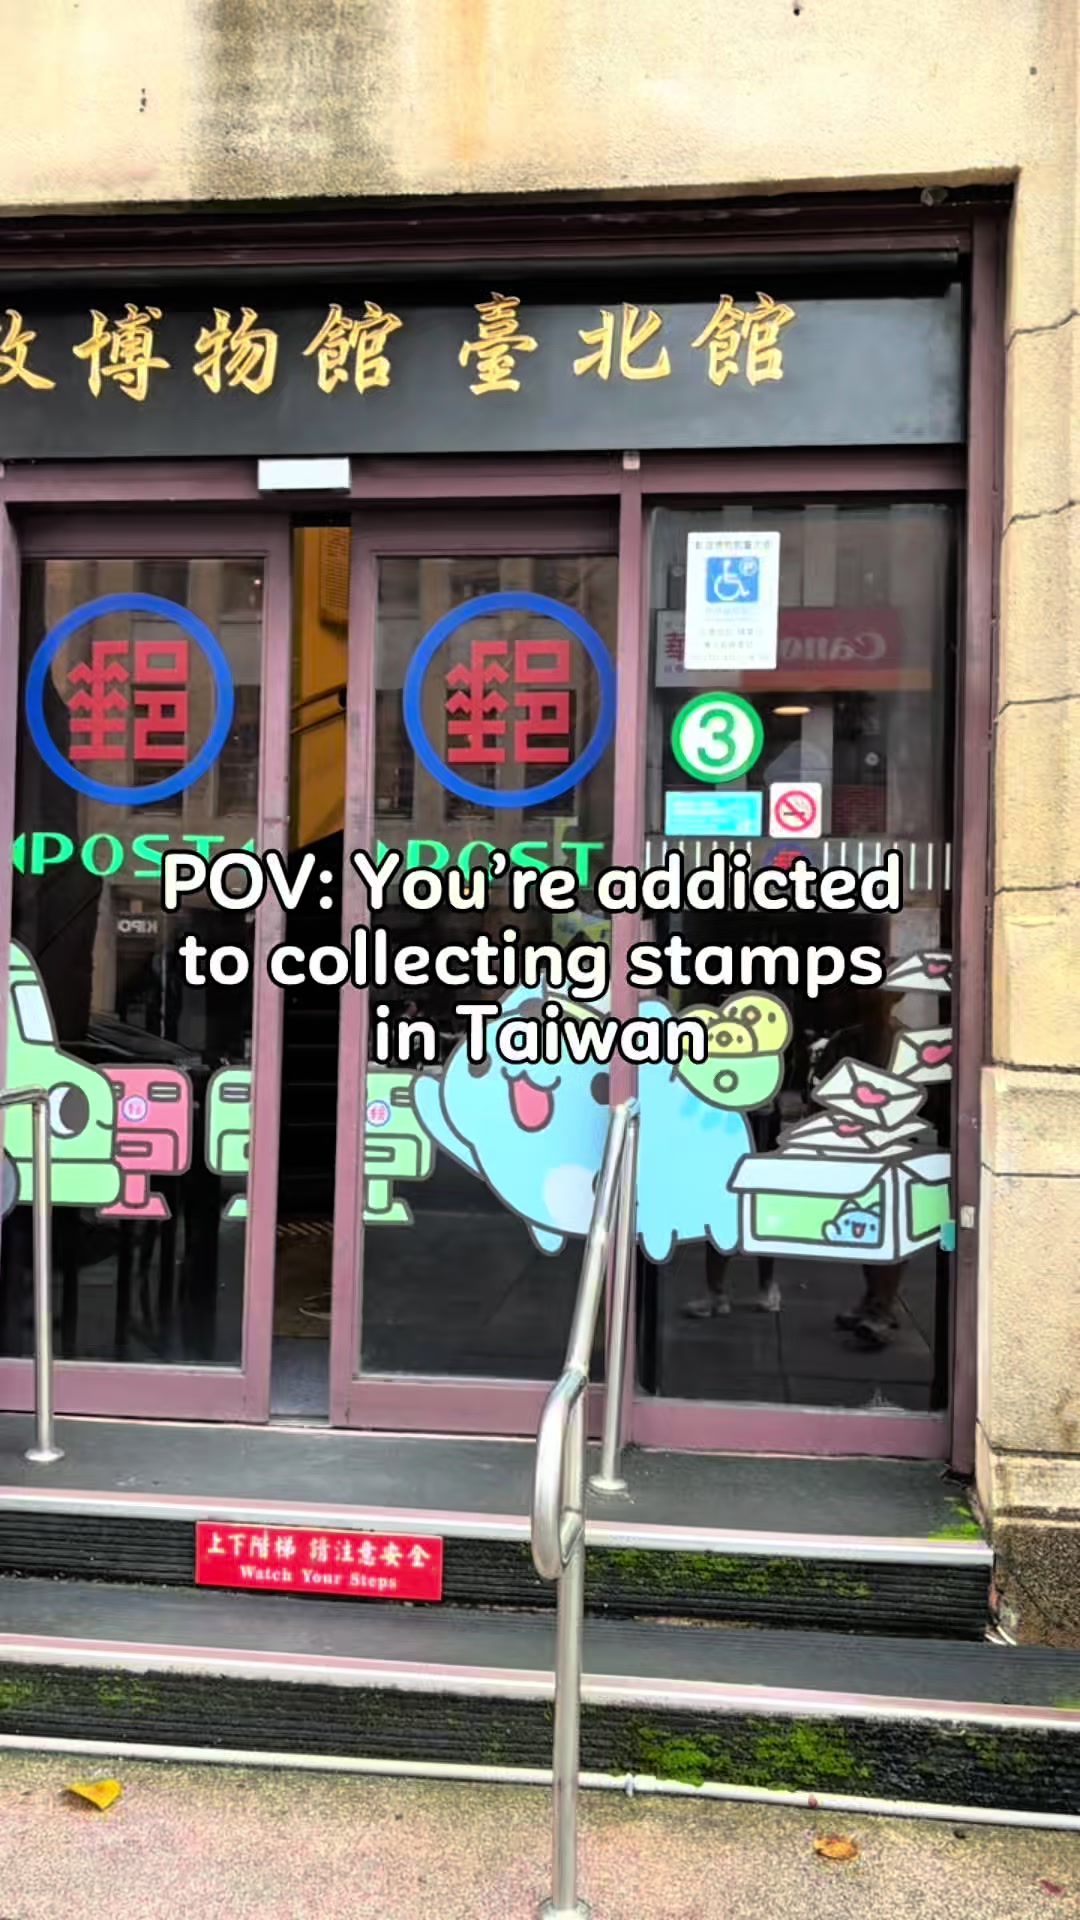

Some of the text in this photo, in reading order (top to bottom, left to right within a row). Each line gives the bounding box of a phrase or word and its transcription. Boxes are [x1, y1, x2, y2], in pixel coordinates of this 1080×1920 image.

[697, 708, 737, 768] 3
[31, 832, 225, 877] POST
[406, 839, 605, 888] POST
[309, 1536, 431, 1567] 請注意安全
[239, 1564, 397, 1592] Watch Your Steps
